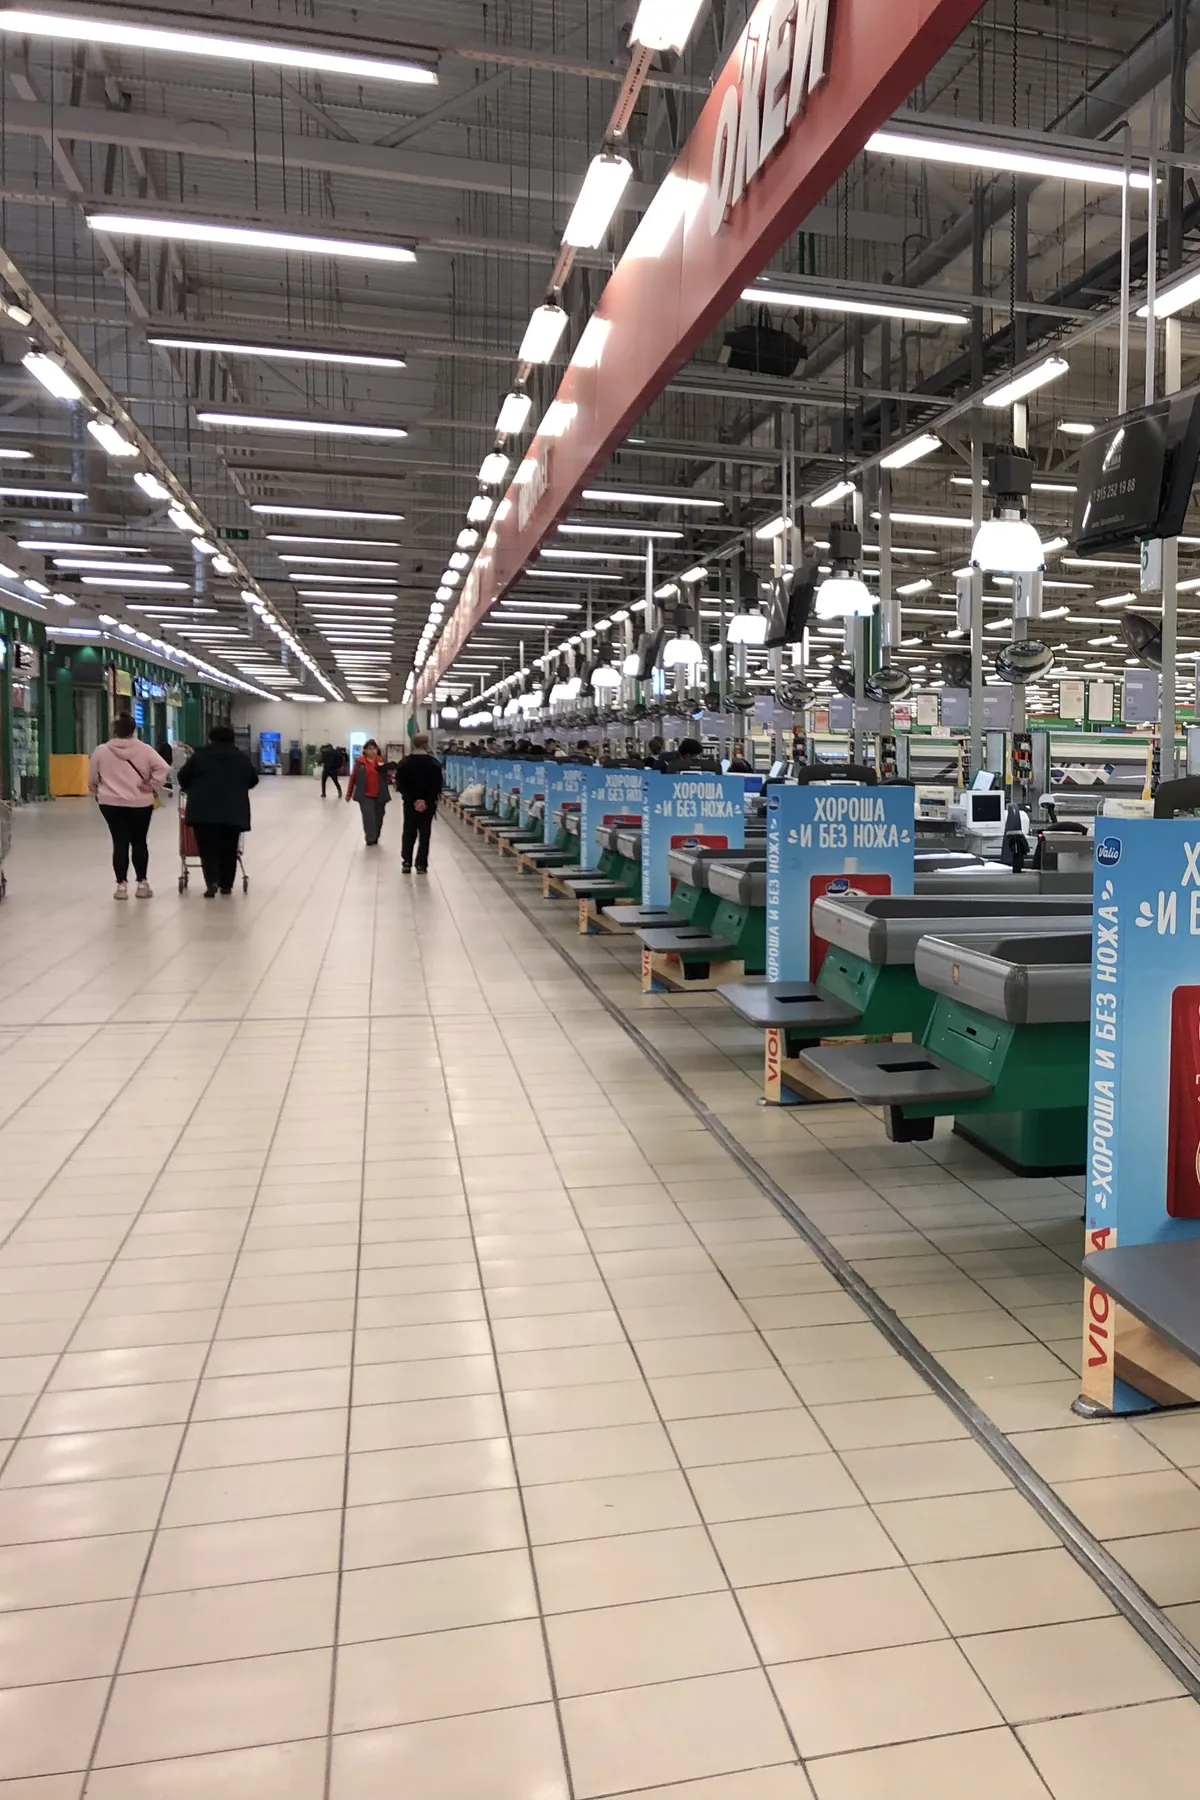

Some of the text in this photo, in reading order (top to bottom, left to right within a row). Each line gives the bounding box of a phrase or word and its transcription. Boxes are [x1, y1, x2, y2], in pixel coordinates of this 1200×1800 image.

[673, 782, 723, 800] ХОРОША
[663, 801, 734, 818] И БЕЗ НОЖА
[813, 797, 885, 822] ХОРОША
[801, 824, 899, 848] И БЕЗ НОЖА
[1097, 846, 1119, 859] Valio
[767, 832, 780, 983] ХОРОША И БЕЗ НОЖА
[1157, 890, 1177, 935] И
[1092, 906, 1119, 1194] ХОРОША И БЕЗ НОЖА
[1088, 1227, 1111, 1367] VIOA
